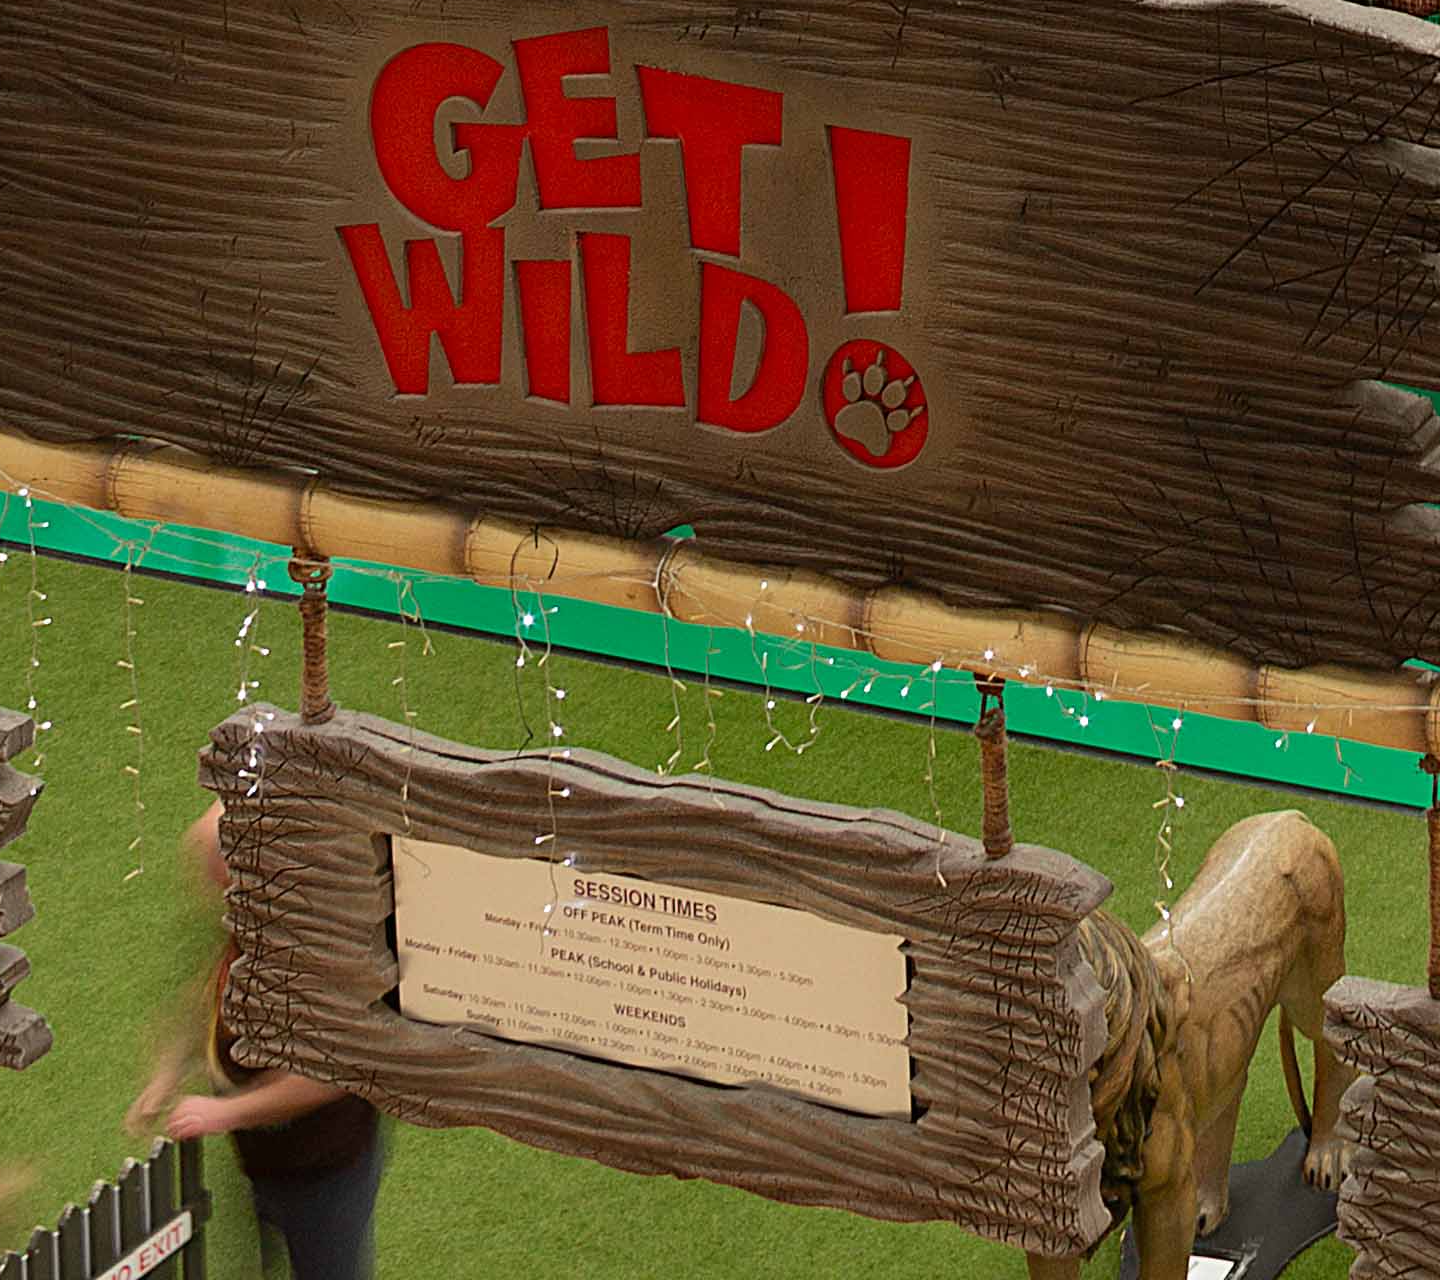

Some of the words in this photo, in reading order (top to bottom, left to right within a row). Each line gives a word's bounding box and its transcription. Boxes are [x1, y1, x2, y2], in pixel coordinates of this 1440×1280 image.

[369, 25, 785, 259] GET
[573, 879, 655, 909] SESSION
[659, 895, 716, 921] TIMES
[563, 906, 586, 920] OFF
[592, 911, 625, 927] PEAK
[628, 919, 662, 937] (Term
[666, 926, 694, 941] Time
[698, 932, 730, 951] Only)
[551, 947, 584, 964] PEAK
[588, 955, 633, 976] (School
[637, 967, 645, 976] &
[649, 968, 686, 985] Public
[690, 976, 745, 999] Holidays)
[614, 1003, 685, 1028] WEEKENDS
[138, 1221, 184, 1272] EXIT
